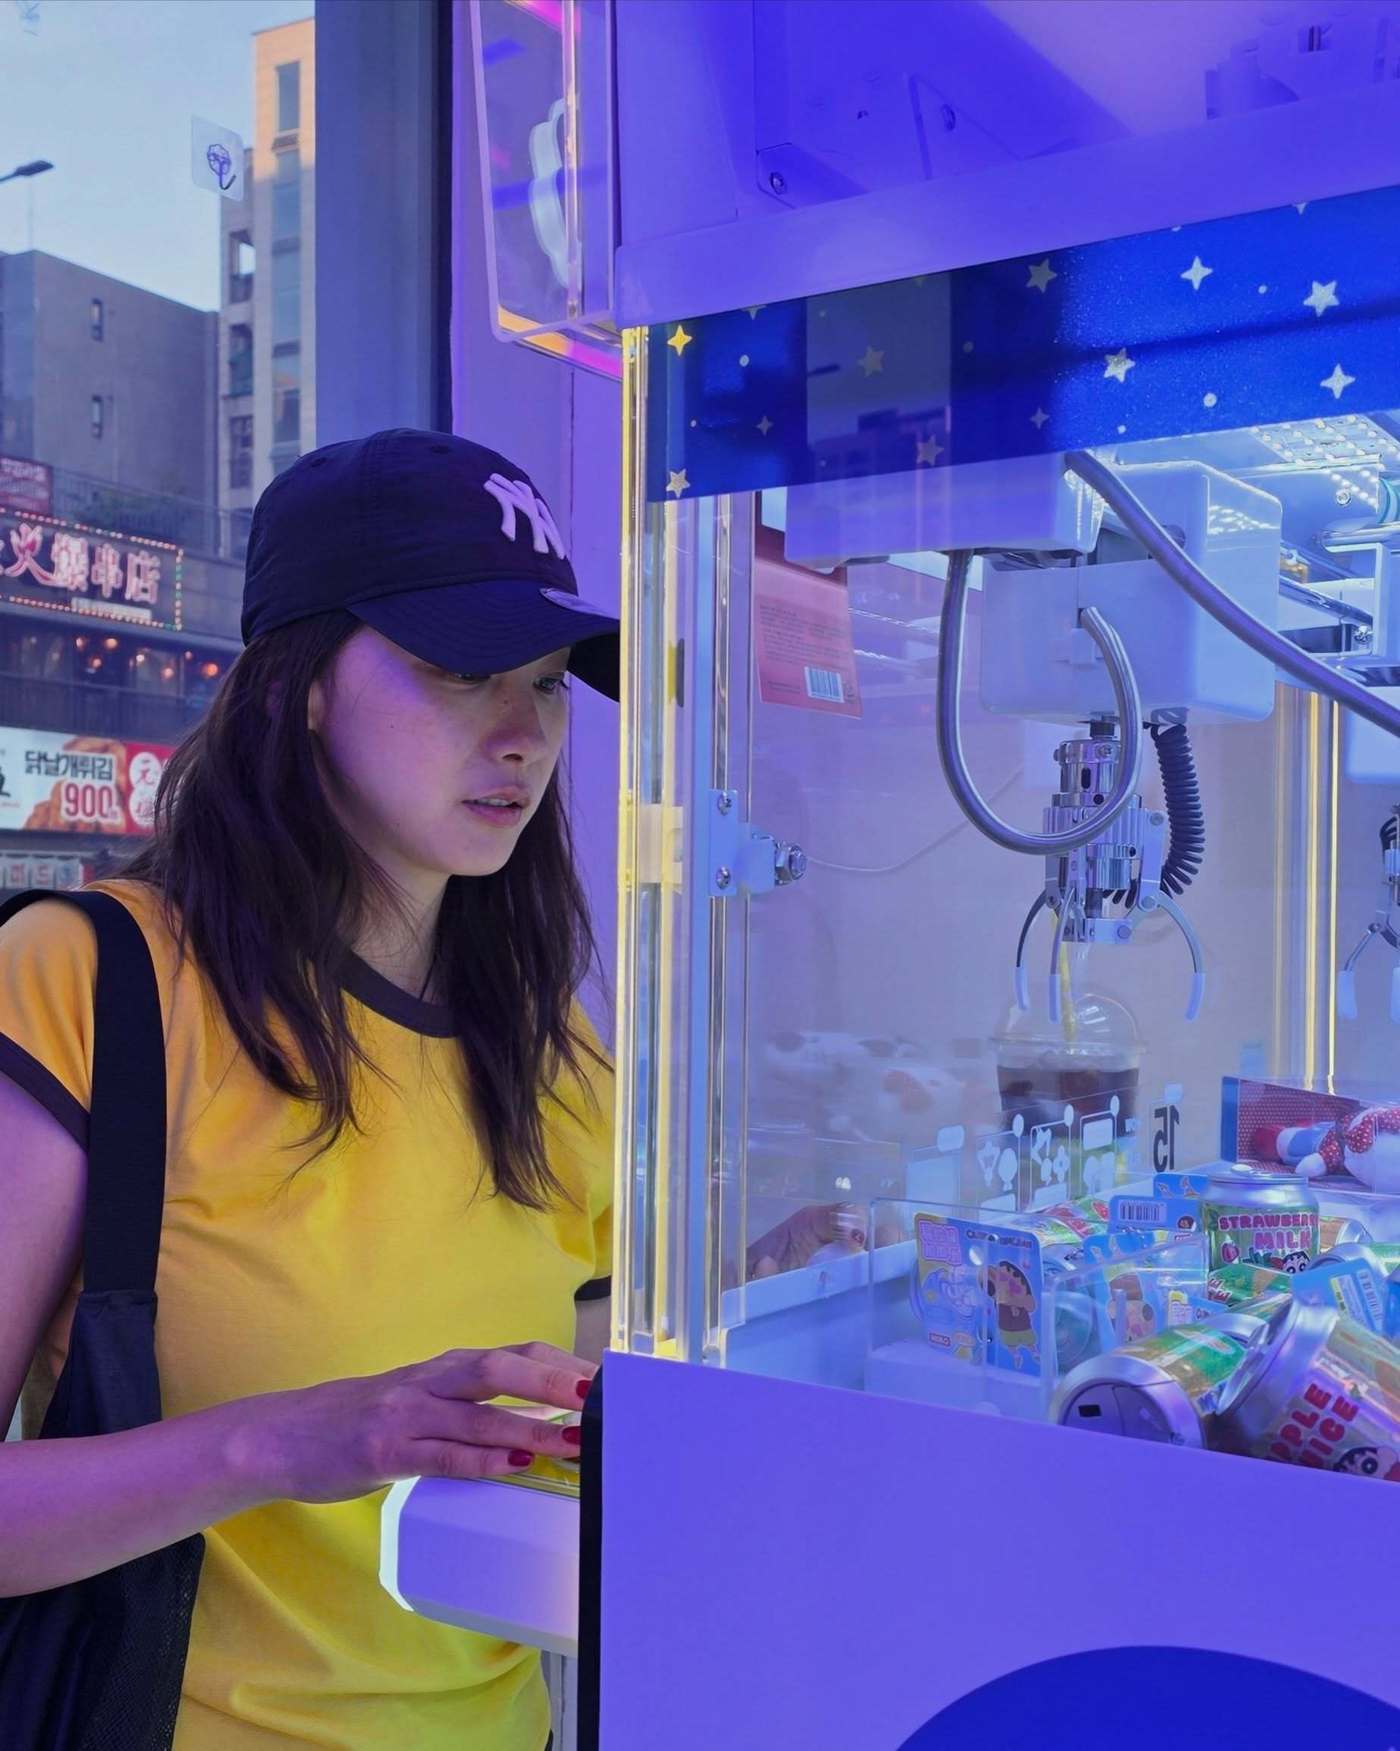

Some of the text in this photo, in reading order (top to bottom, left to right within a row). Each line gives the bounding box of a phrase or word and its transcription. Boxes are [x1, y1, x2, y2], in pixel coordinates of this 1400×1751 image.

[0, 523, 161, 604] 火爆串店
[24, 750, 114, 782] 닭날개튀김
[1253, 1229, 1312, 1250] MILK
[1269, 1383, 1332, 1463] PPLE
